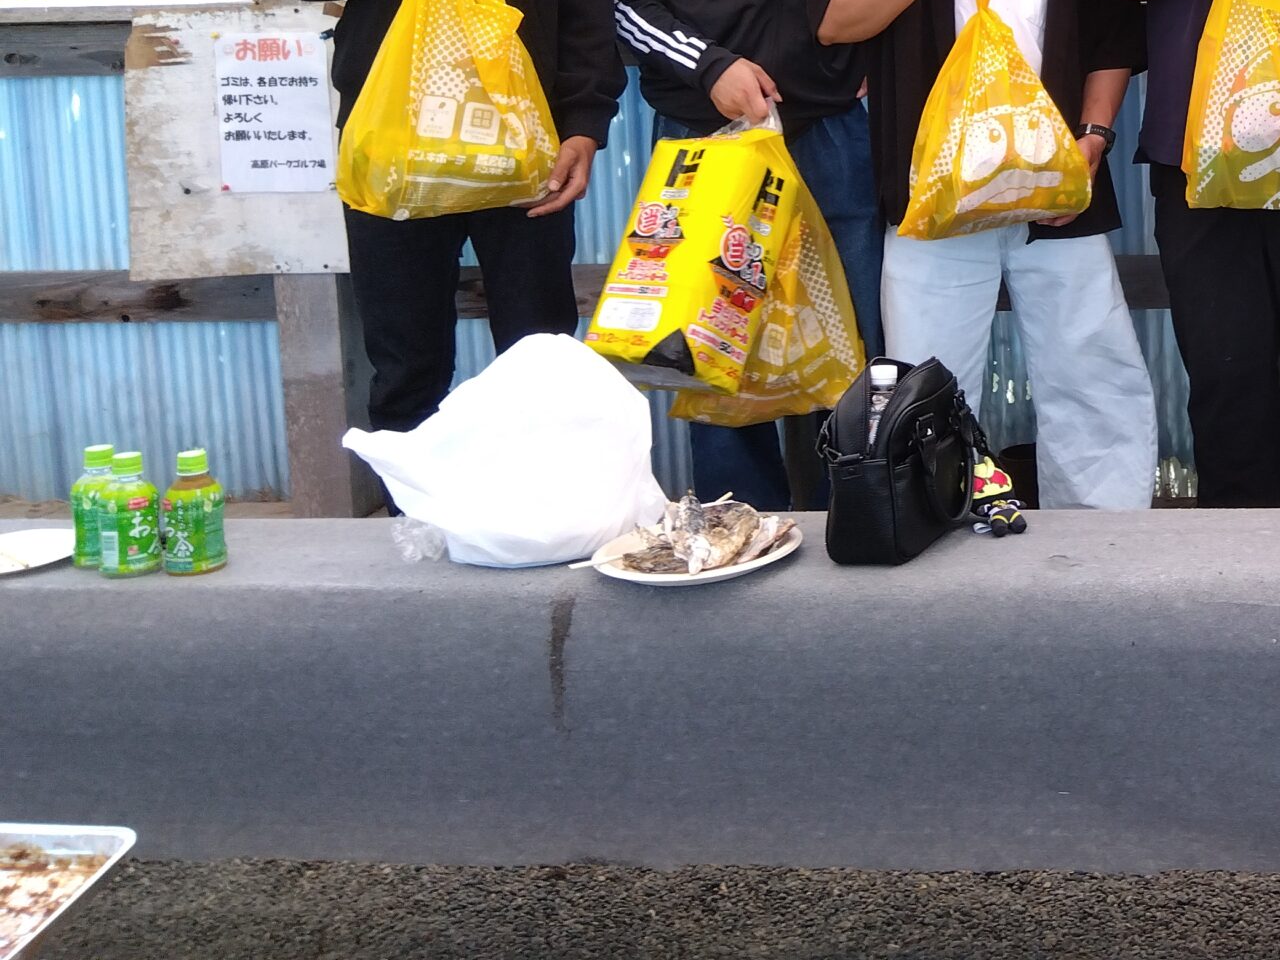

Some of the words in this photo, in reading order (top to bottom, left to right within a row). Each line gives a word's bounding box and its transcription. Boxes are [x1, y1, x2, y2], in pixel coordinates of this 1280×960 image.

[234, 38, 303, 62] お願い
[220, 76, 318, 88] ゴミは、各自でお持ち
[222, 94, 279, 106] 帰り下さい。
[223, 112, 263, 124] よろしく
[223, 130, 313, 142] お願いいたします。
[250, 159, 327, 170] 高原パークゴルフ場
